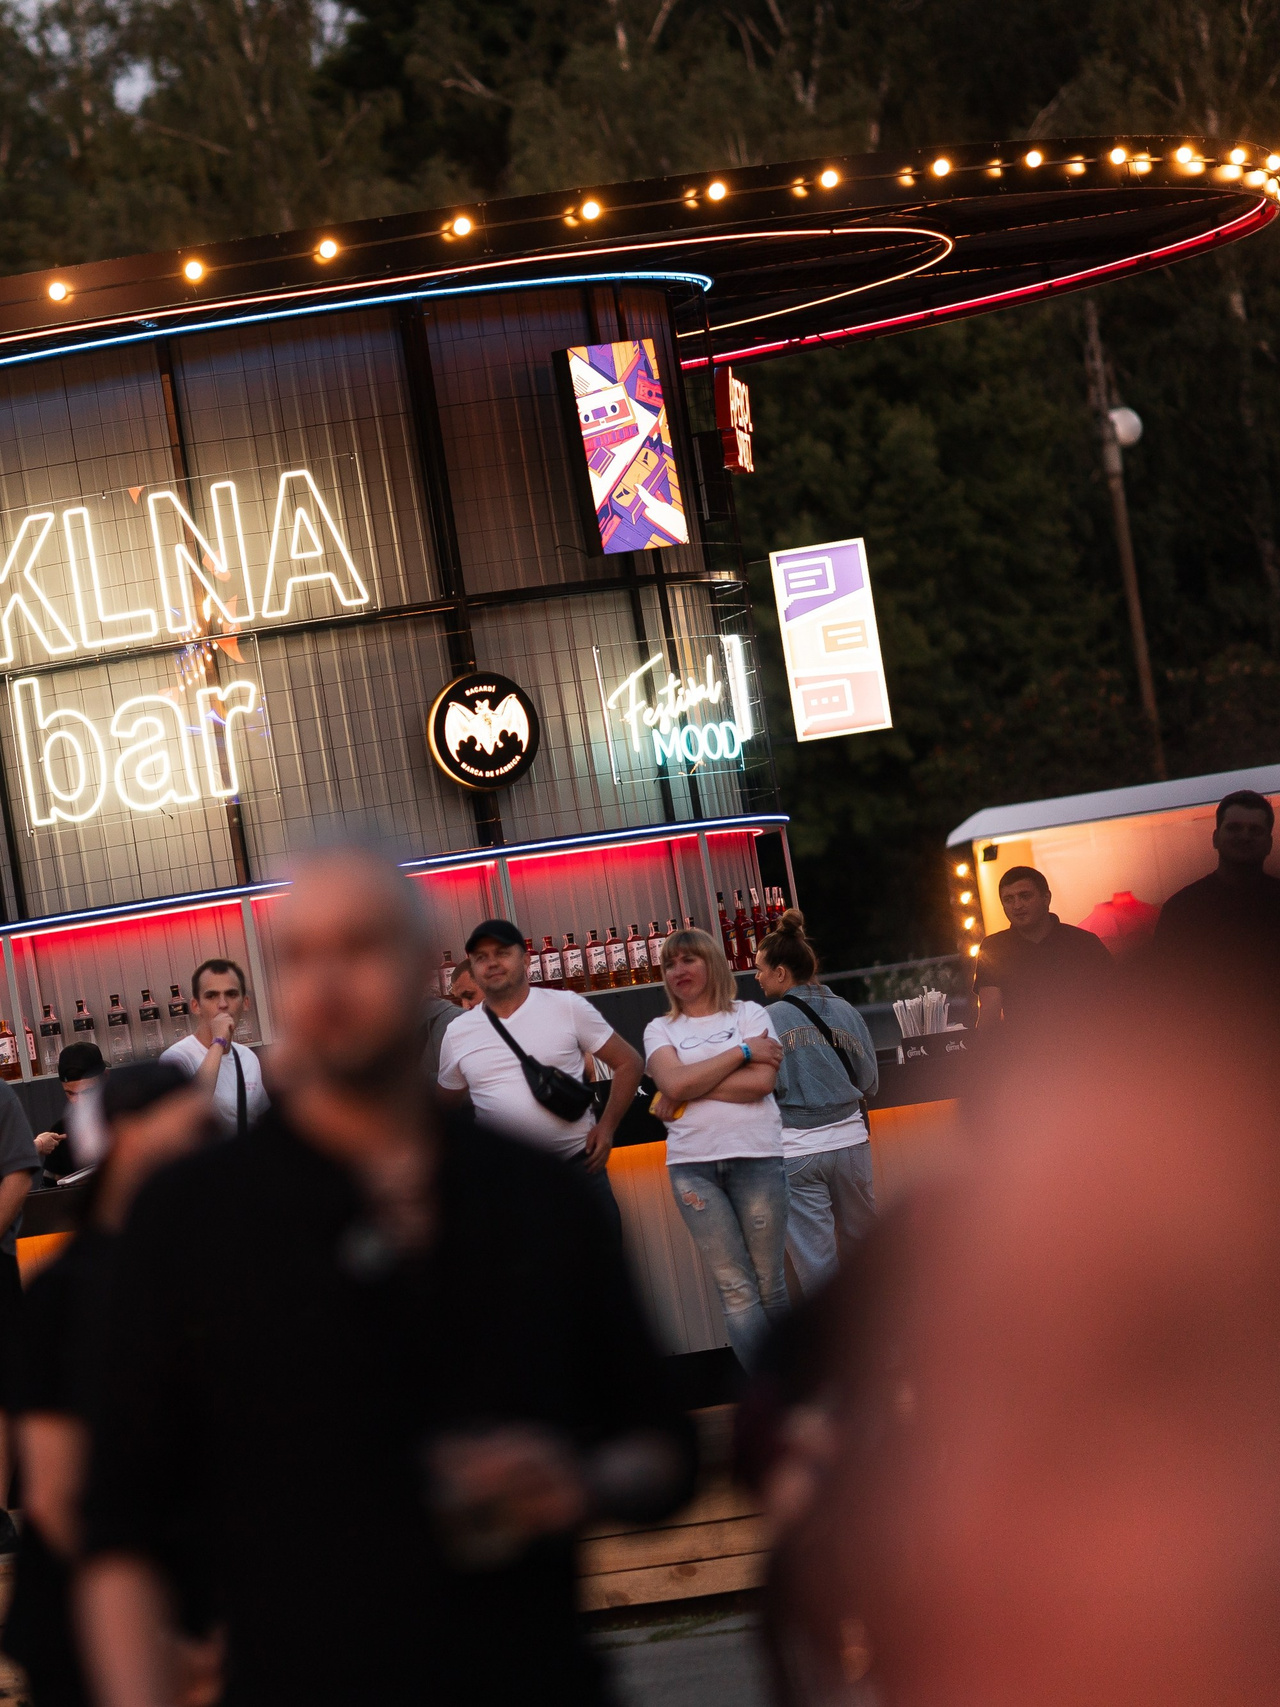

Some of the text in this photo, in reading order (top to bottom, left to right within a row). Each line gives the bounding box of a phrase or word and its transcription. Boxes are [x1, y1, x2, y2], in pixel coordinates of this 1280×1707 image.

[607, 652, 721, 752] Festival
[13, 676, 257, 827] bar
[460, 762, 484, 777] MARCA
[652, 721, 741, 766] MOOD
